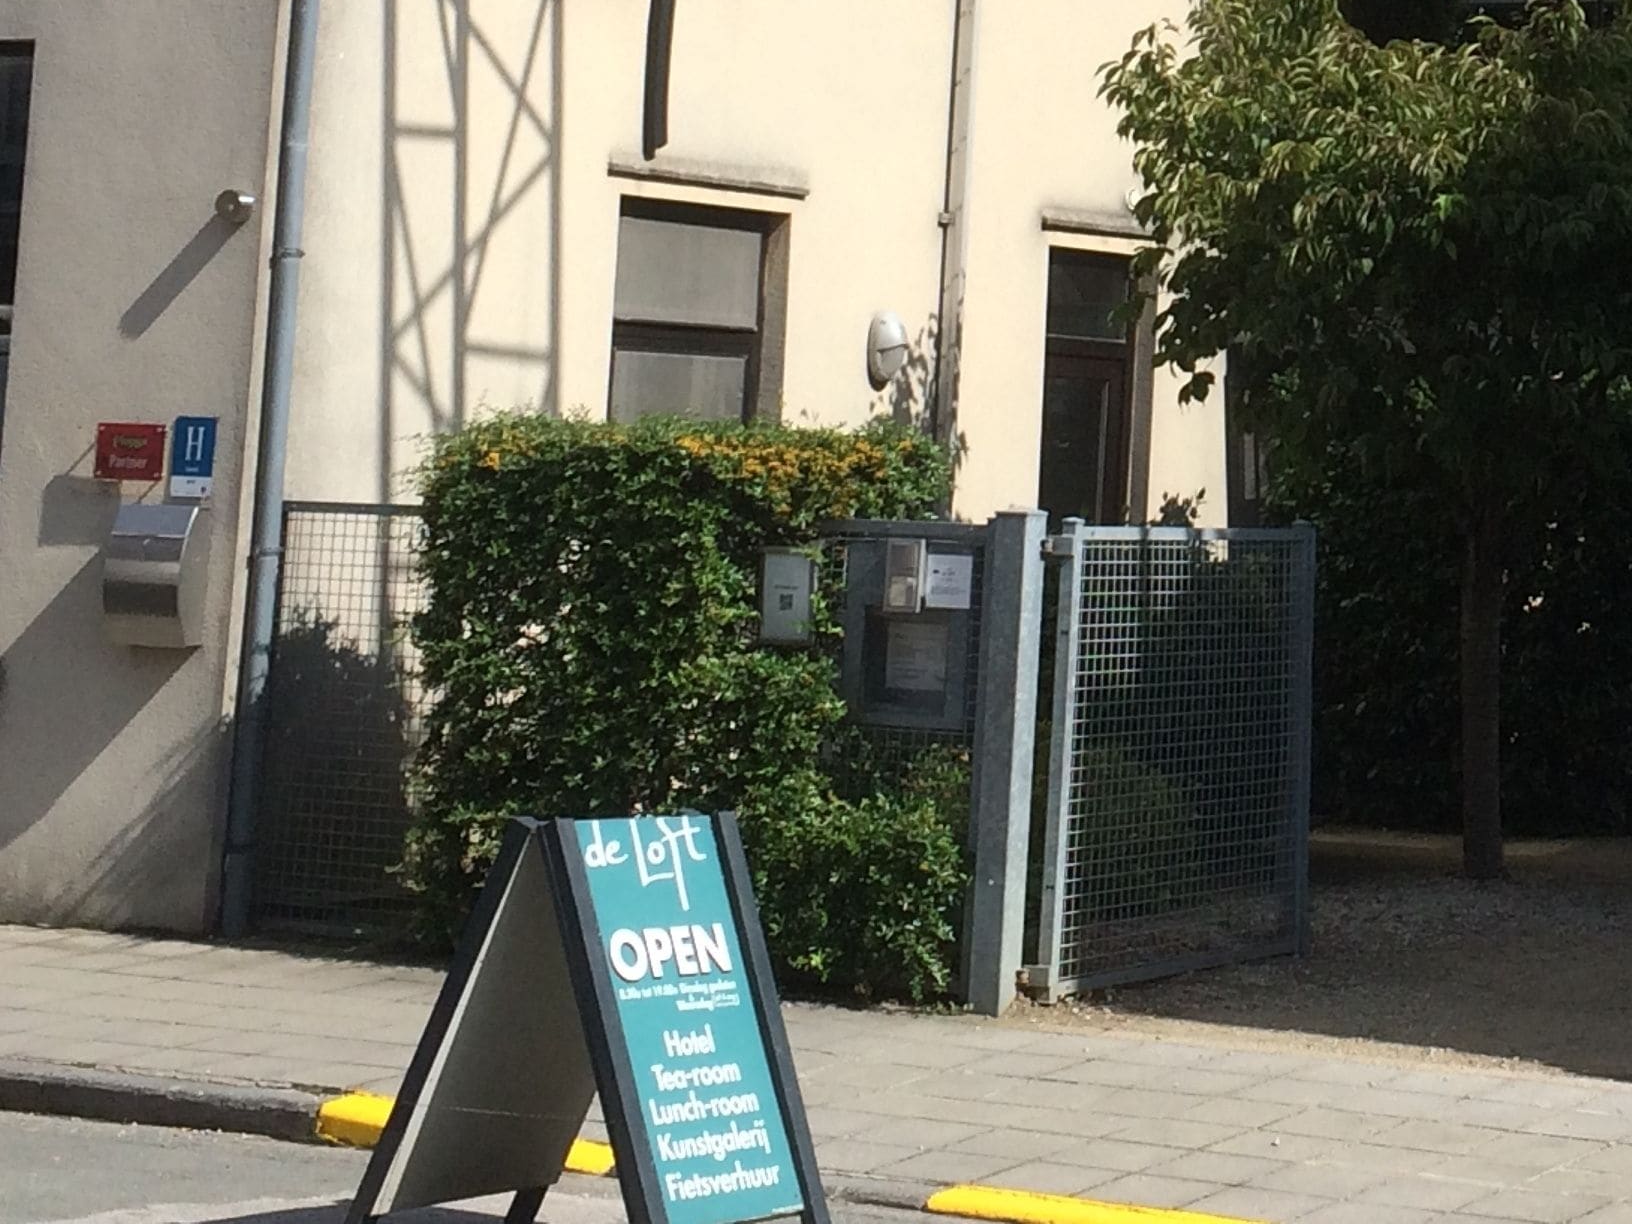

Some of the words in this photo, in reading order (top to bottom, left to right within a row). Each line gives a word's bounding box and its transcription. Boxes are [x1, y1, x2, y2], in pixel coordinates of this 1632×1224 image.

[184, 426, 205, 462] H
[584, 819, 629, 868] de
[629, 815, 707, 911] Loft
[609, 923, 733, 982] OPEN
[663, 1022, 716, 1058] Hotel
[650, 1062, 742, 1092] Tea-room
[648, 1090, 760, 1126] Lunch-room
[656, 1119, 772, 1162] Kunstgalerij
[665, 1160, 780, 1202] Fietsverhuur
